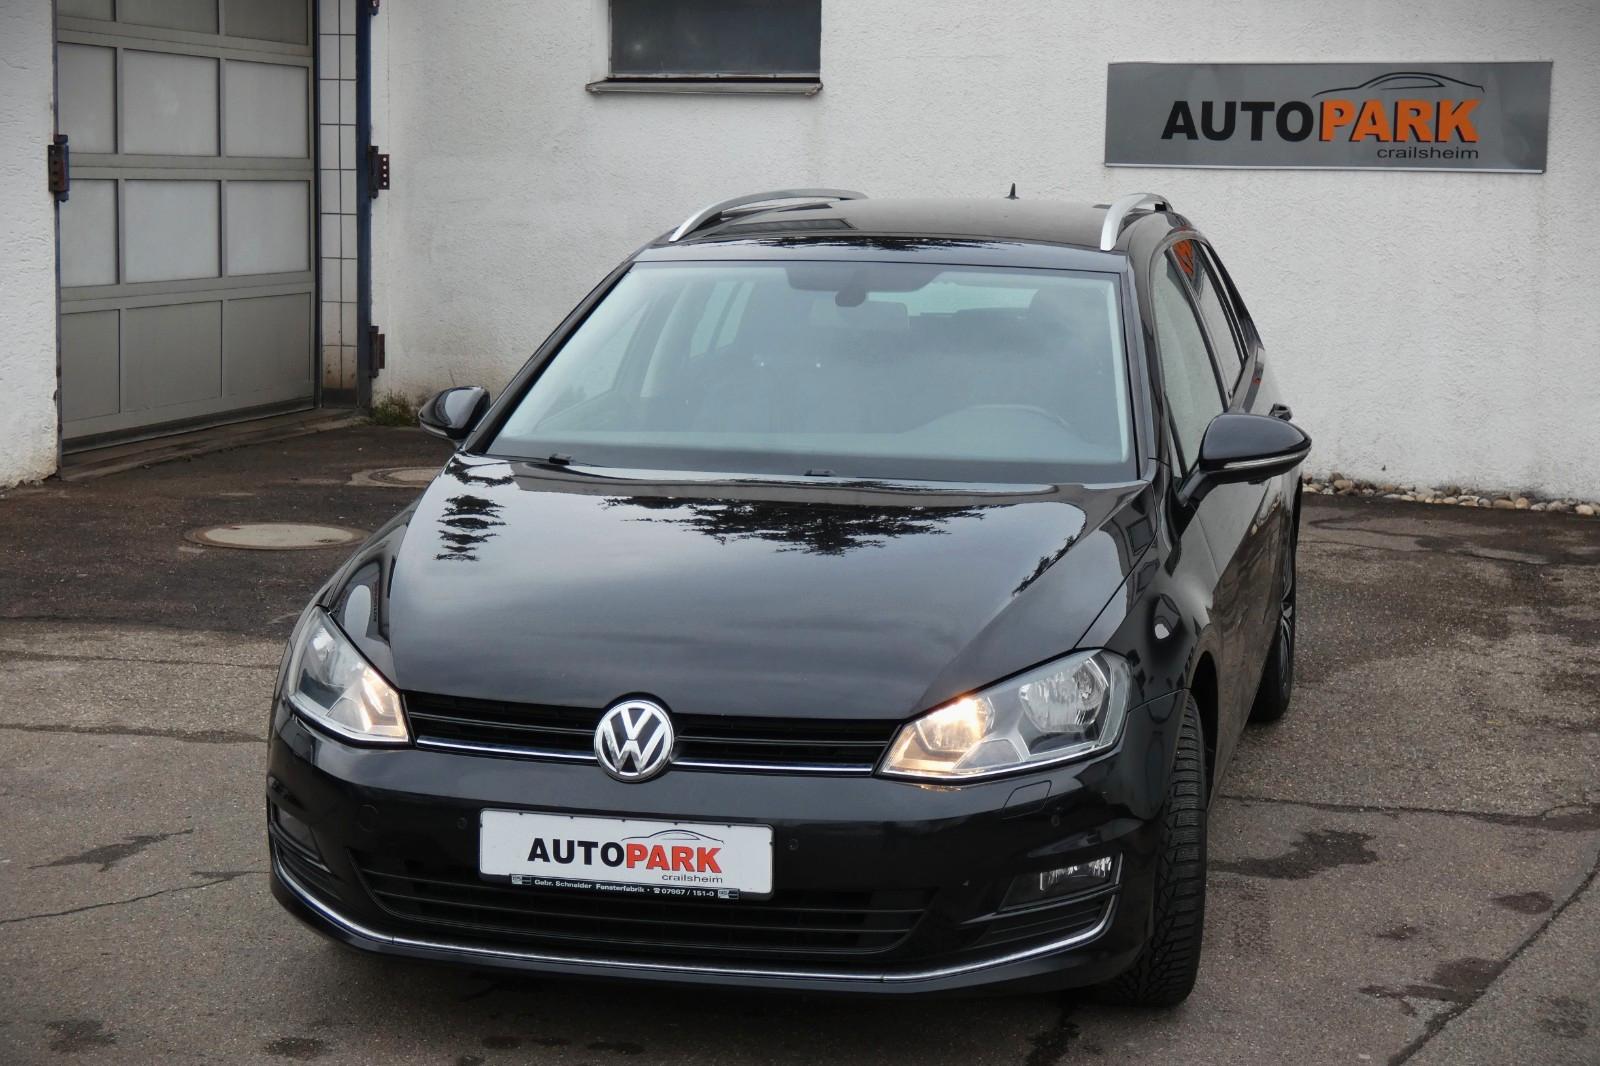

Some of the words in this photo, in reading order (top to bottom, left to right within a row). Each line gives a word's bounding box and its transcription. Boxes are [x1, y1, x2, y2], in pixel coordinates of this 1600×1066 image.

[1161, 100, 1480, 143] AUTOPARK
[1377, 145, 1479, 159] crailsheim
[527, 838, 722, 873] AUTOPARK
[661, 874, 723, 883] crailsheim
[555, 881, 592, 889] Schneider
[595, 883, 645, 893] Fensterfabrik
